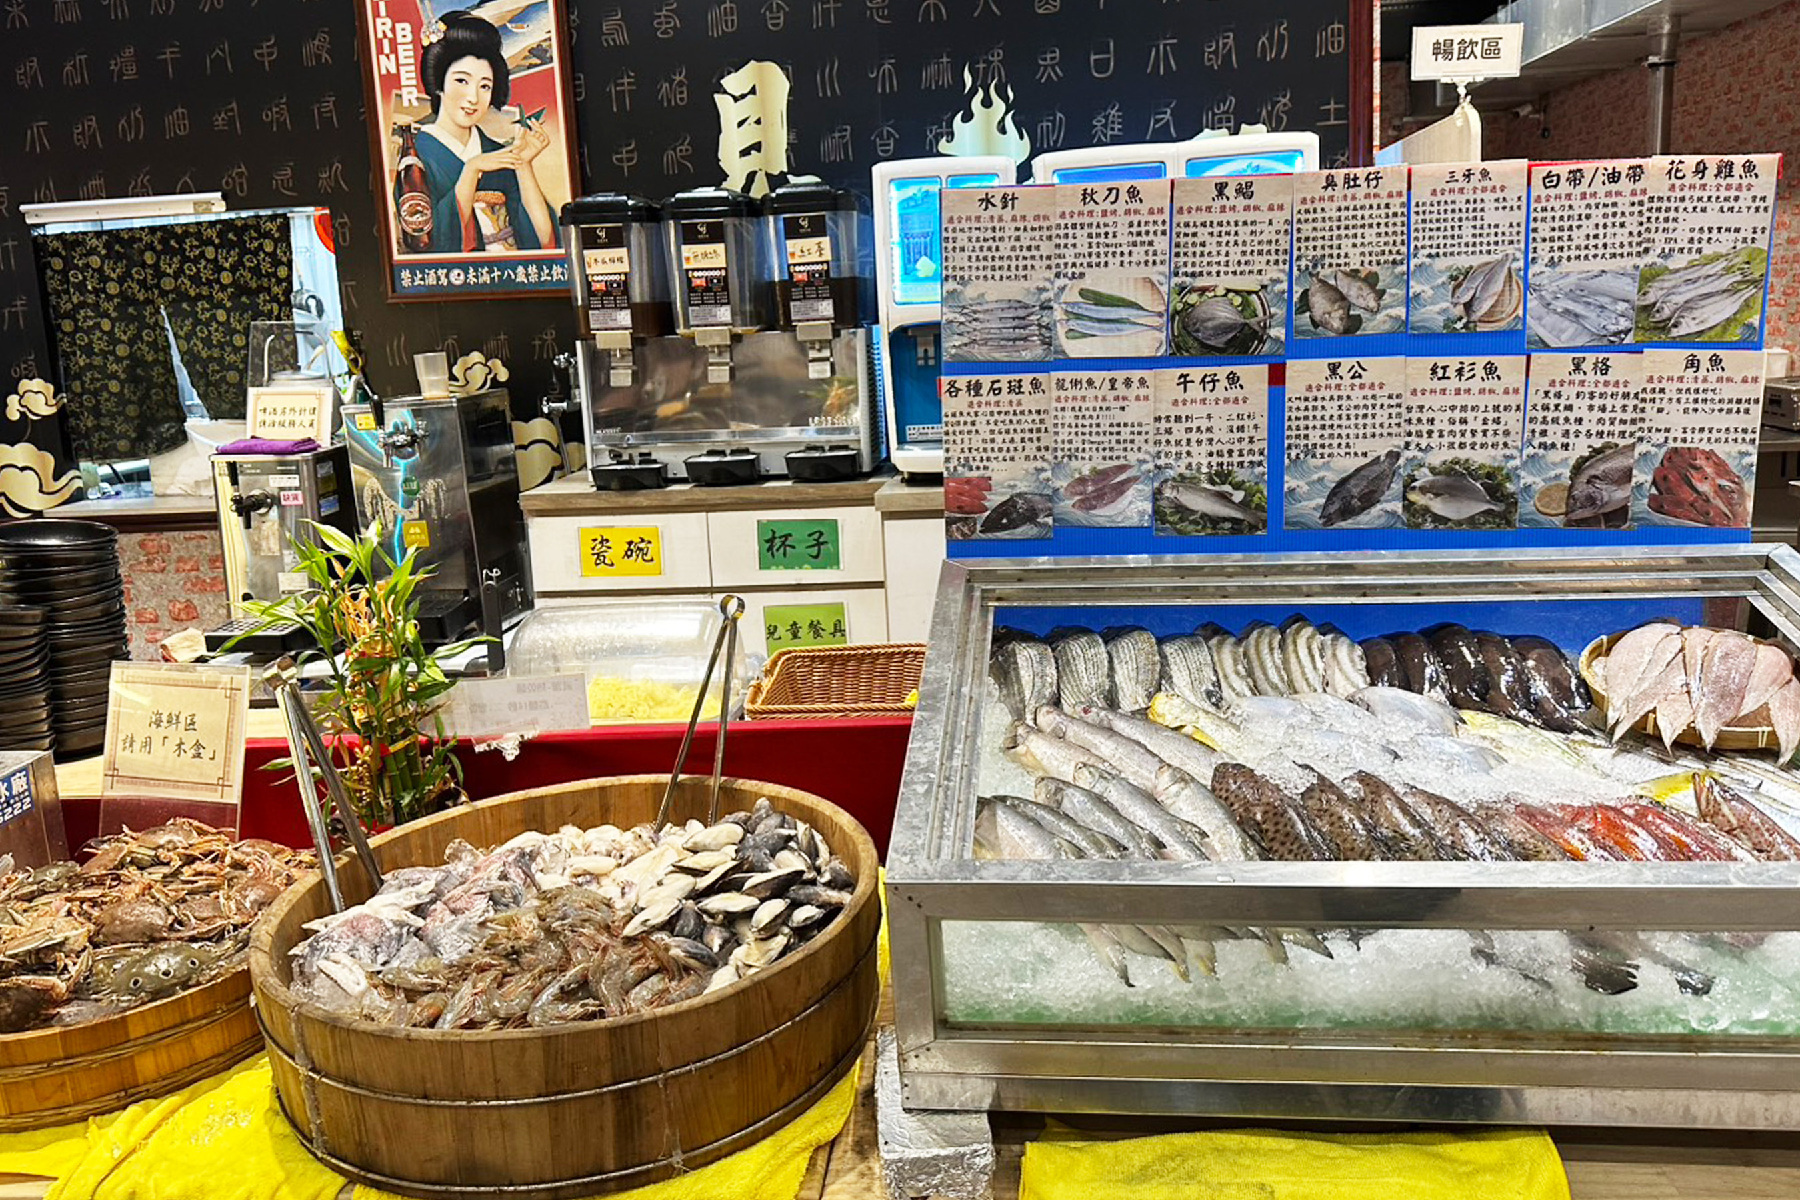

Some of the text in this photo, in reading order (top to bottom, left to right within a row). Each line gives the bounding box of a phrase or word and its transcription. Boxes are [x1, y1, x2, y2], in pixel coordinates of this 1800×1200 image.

[374, 0, 397, 76] IRIN
[1433, 37, 1503, 62] 暢飲區
[395, 22, 419, 107] BEER
[1445, 167, 1492, 184] 三牙魚
[1542, 164, 1645, 189] 白帶/油帶
[1665, 158, 1759, 180] 花身雞魚
[1212, 181, 1254, 202] 黑鯧
[1321, 171, 1383, 191] 臭肚仔
[977, 192, 1019, 211] 水針
[1080, 185, 1143, 206] 秋刀魚
[400, 269, 448, 287] 禁止酒駕
[1325, 361, 1368, 381] 黑公
[1568, 356, 1612, 376] 黑格
[1683, 353, 1725, 373] 角魚
[944, 377, 1045, 398] 各種石斑魚
[1176, 370, 1244, 393] 午仔魚
[590, 534, 655, 568] 瓷碗
[763, 529, 829, 561] 杯子
[766, 619, 846, 641] 兒童餐具
[120, 732, 216, 761] 請用「木盒」
